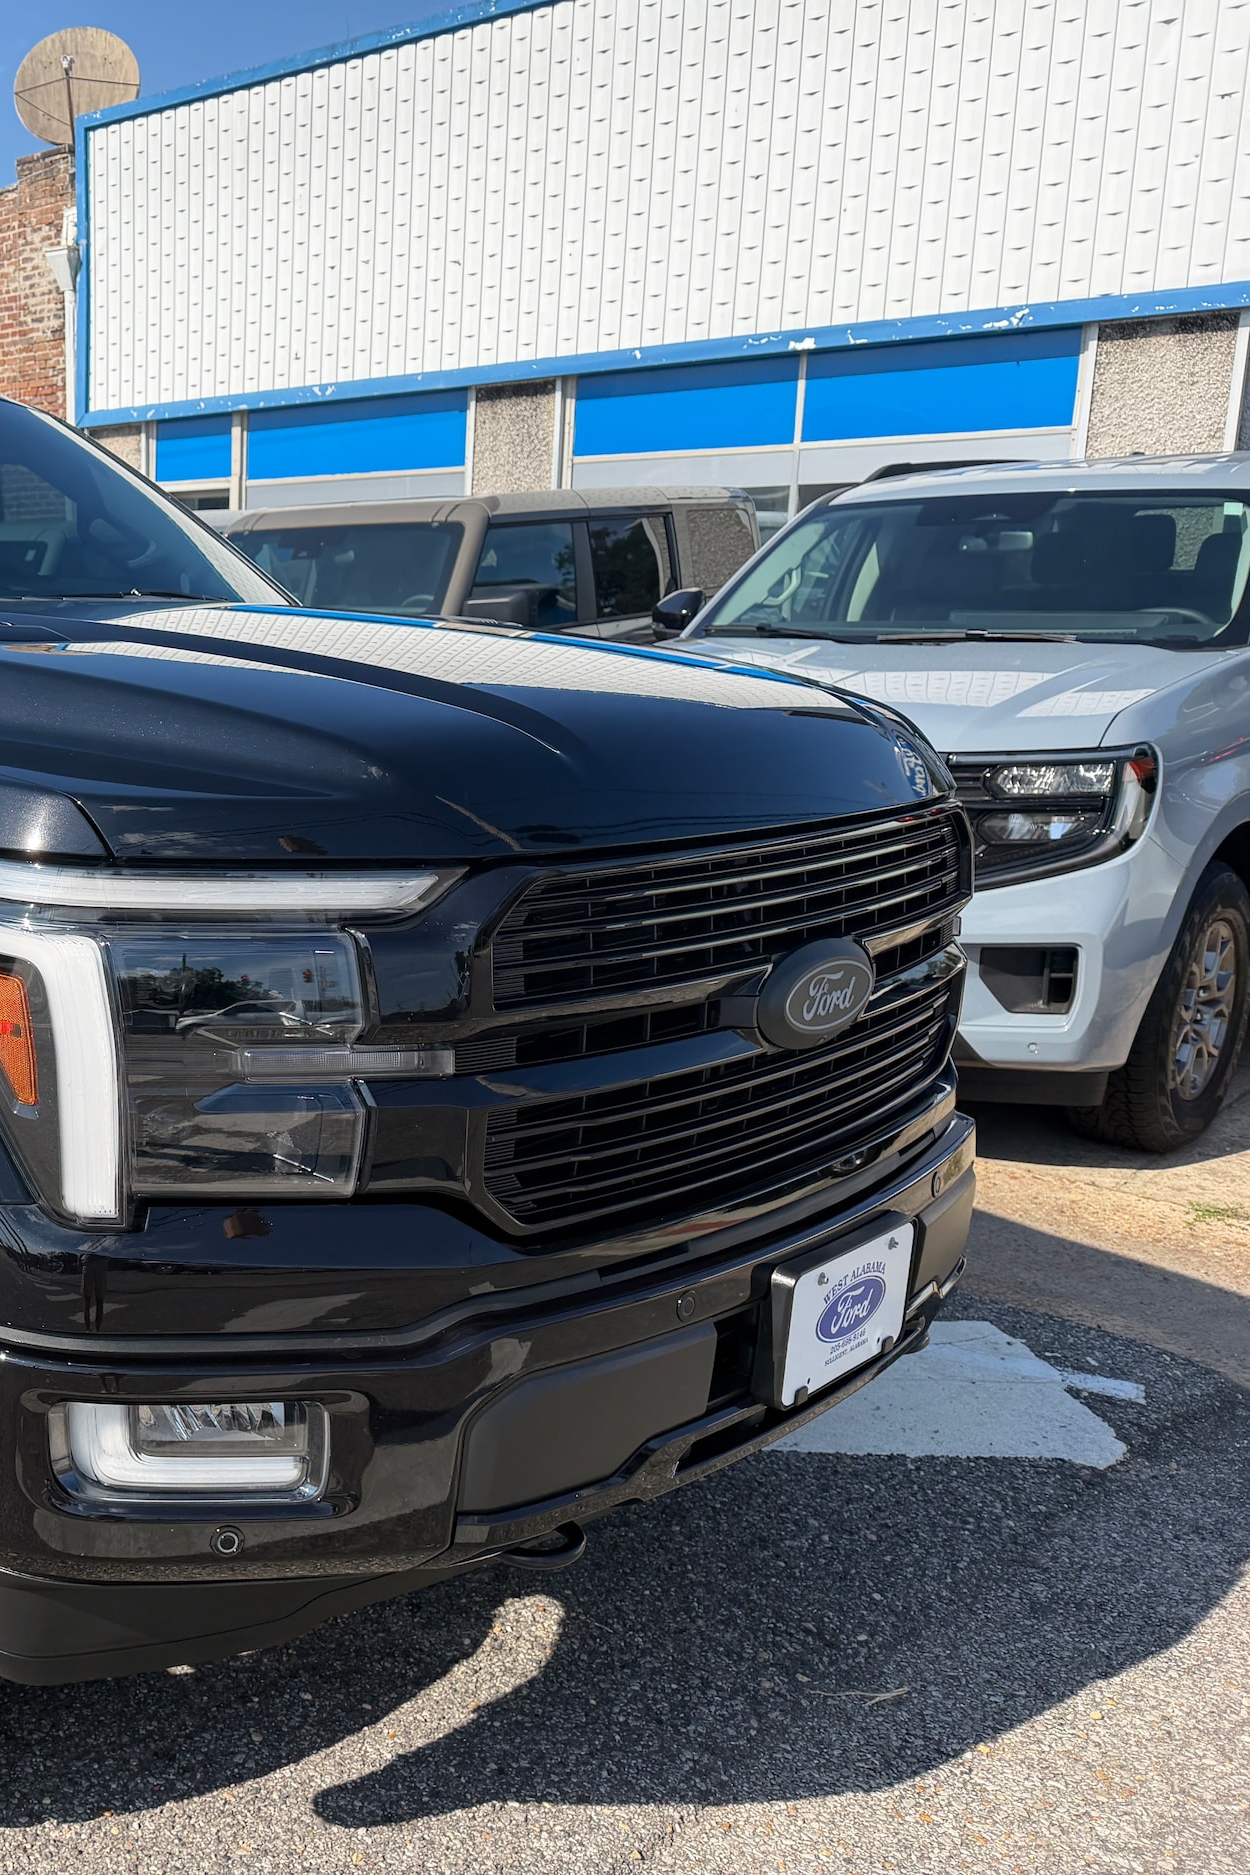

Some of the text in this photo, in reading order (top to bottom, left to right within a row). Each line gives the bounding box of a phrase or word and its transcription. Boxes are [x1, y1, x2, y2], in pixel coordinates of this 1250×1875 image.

[803, 970, 857, 1021] Ford
[823, 1261, 887, 1305] WEST ALABAMA
[830, 1286, 874, 1335] Ford
